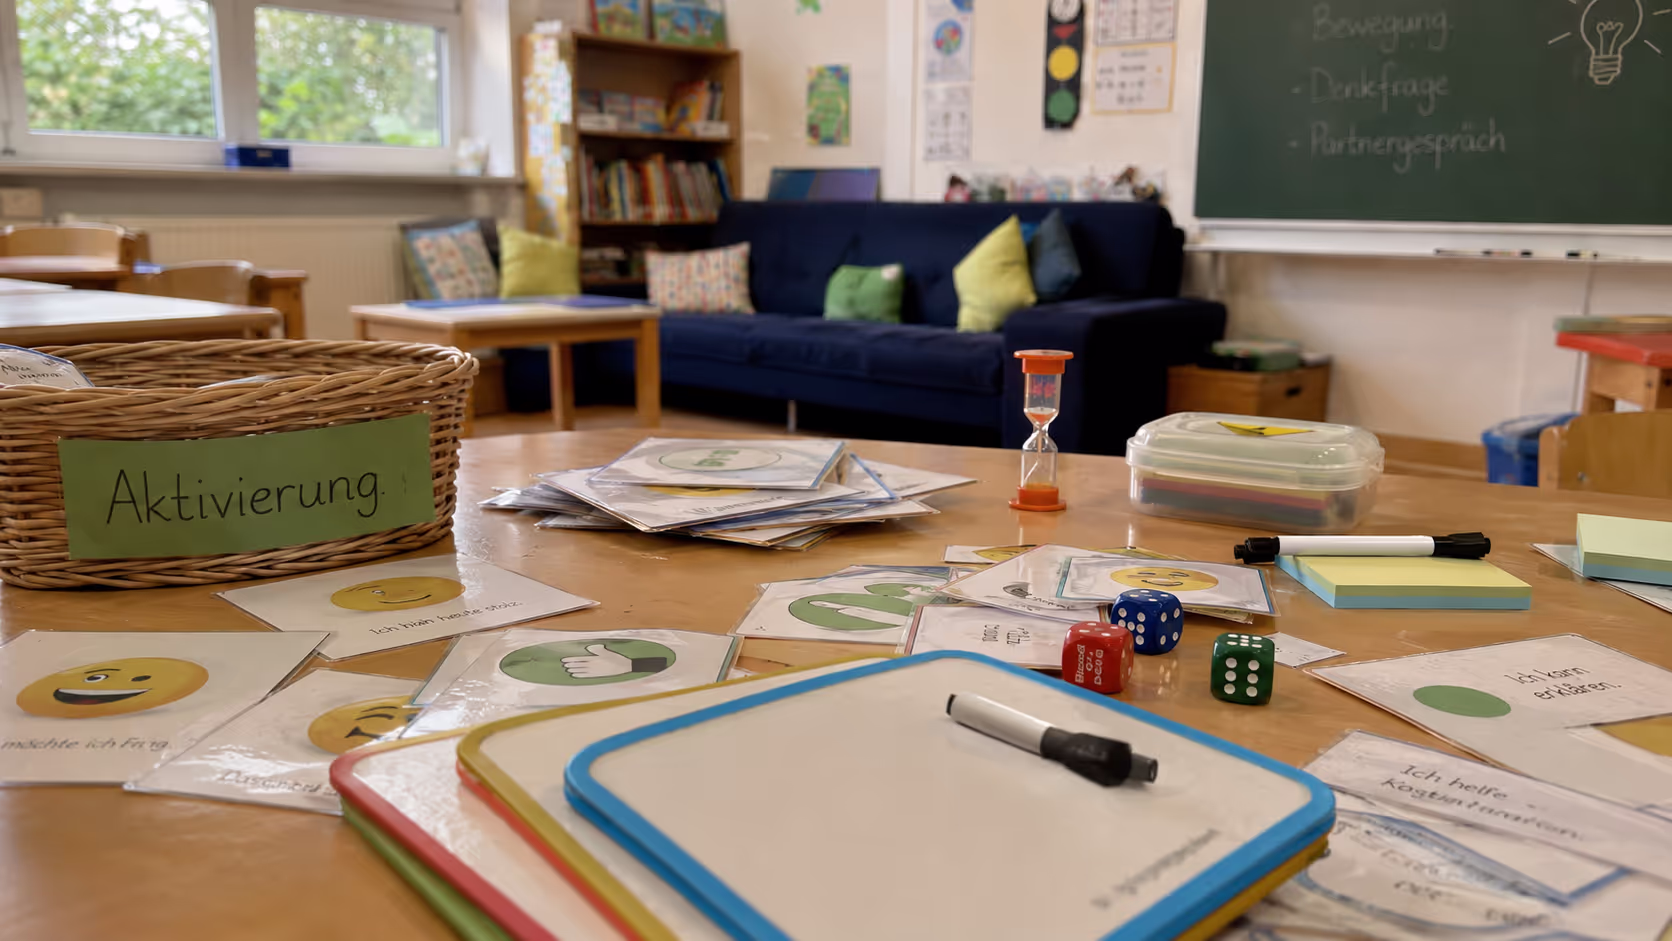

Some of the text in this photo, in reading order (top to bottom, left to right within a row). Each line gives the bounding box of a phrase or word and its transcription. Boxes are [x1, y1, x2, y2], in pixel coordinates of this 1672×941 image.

[1310, 61, 1450, 117] Denkfrage
[1310, 117, 1506, 174] Partnergespräch
[1503, 671, 1548, 685] Ich
[1399, 764, 1509, 800] Ich helfe
